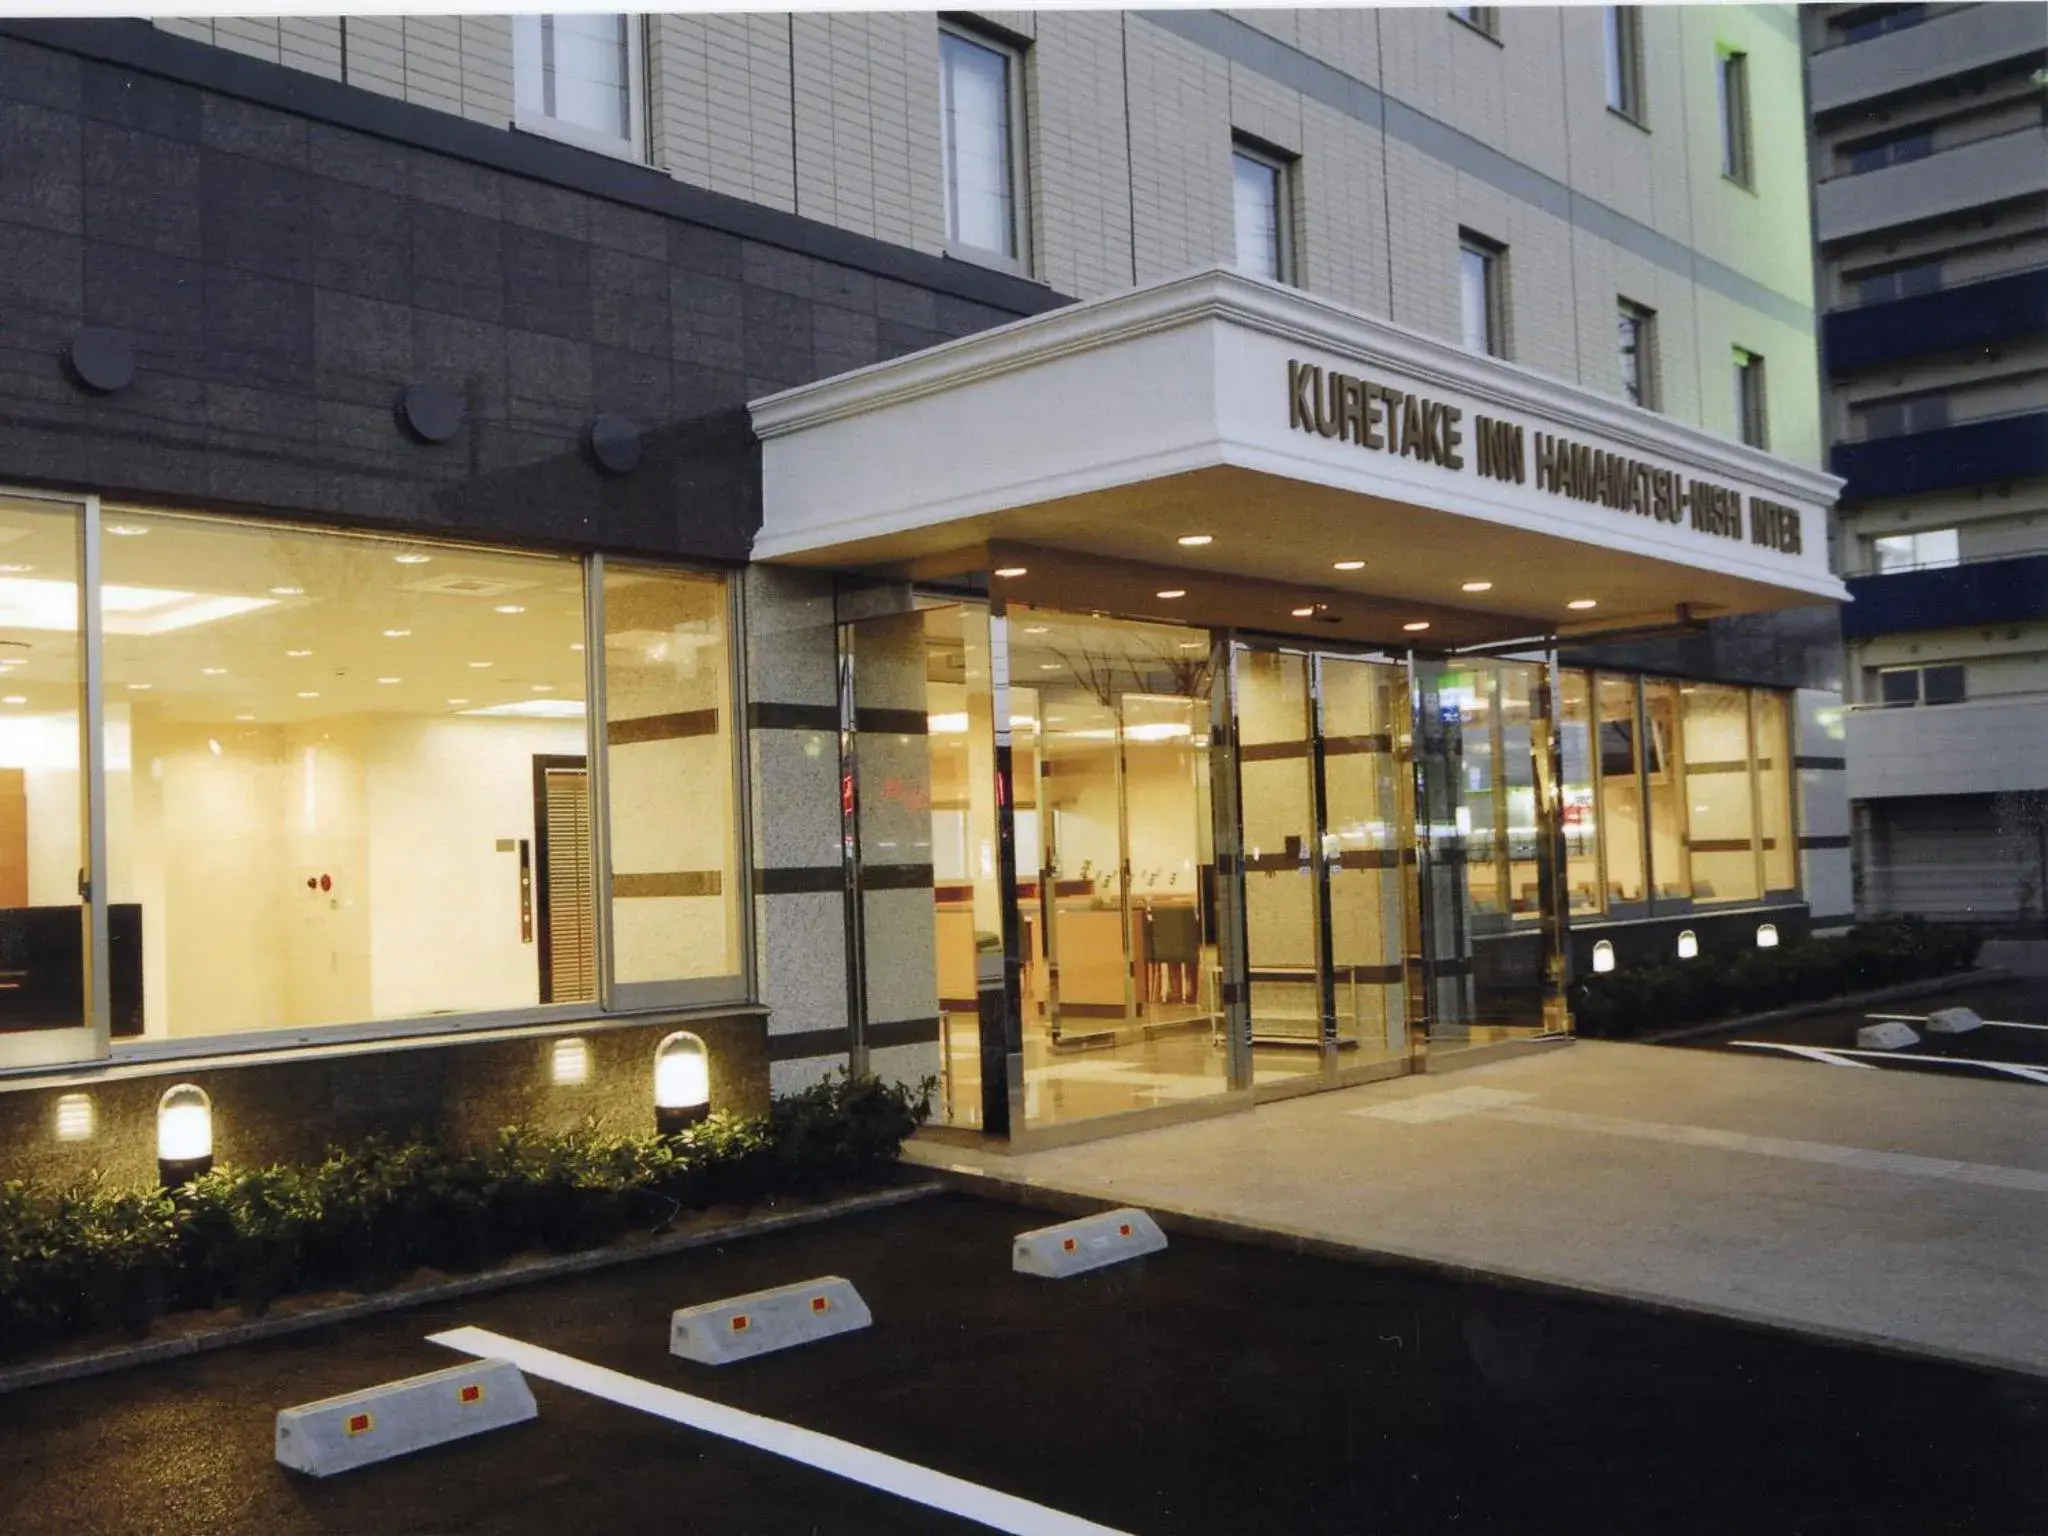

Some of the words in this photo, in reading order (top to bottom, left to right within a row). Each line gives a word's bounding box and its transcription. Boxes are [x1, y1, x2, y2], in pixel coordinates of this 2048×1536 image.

[1288, 359, 1464, 470] KURETAKE
[1475, 414, 1525, 484] INN
[1535, 431, 1742, 540] HAMAMATSU-NISHI
[1750, 496, 1802, 555] INTER
